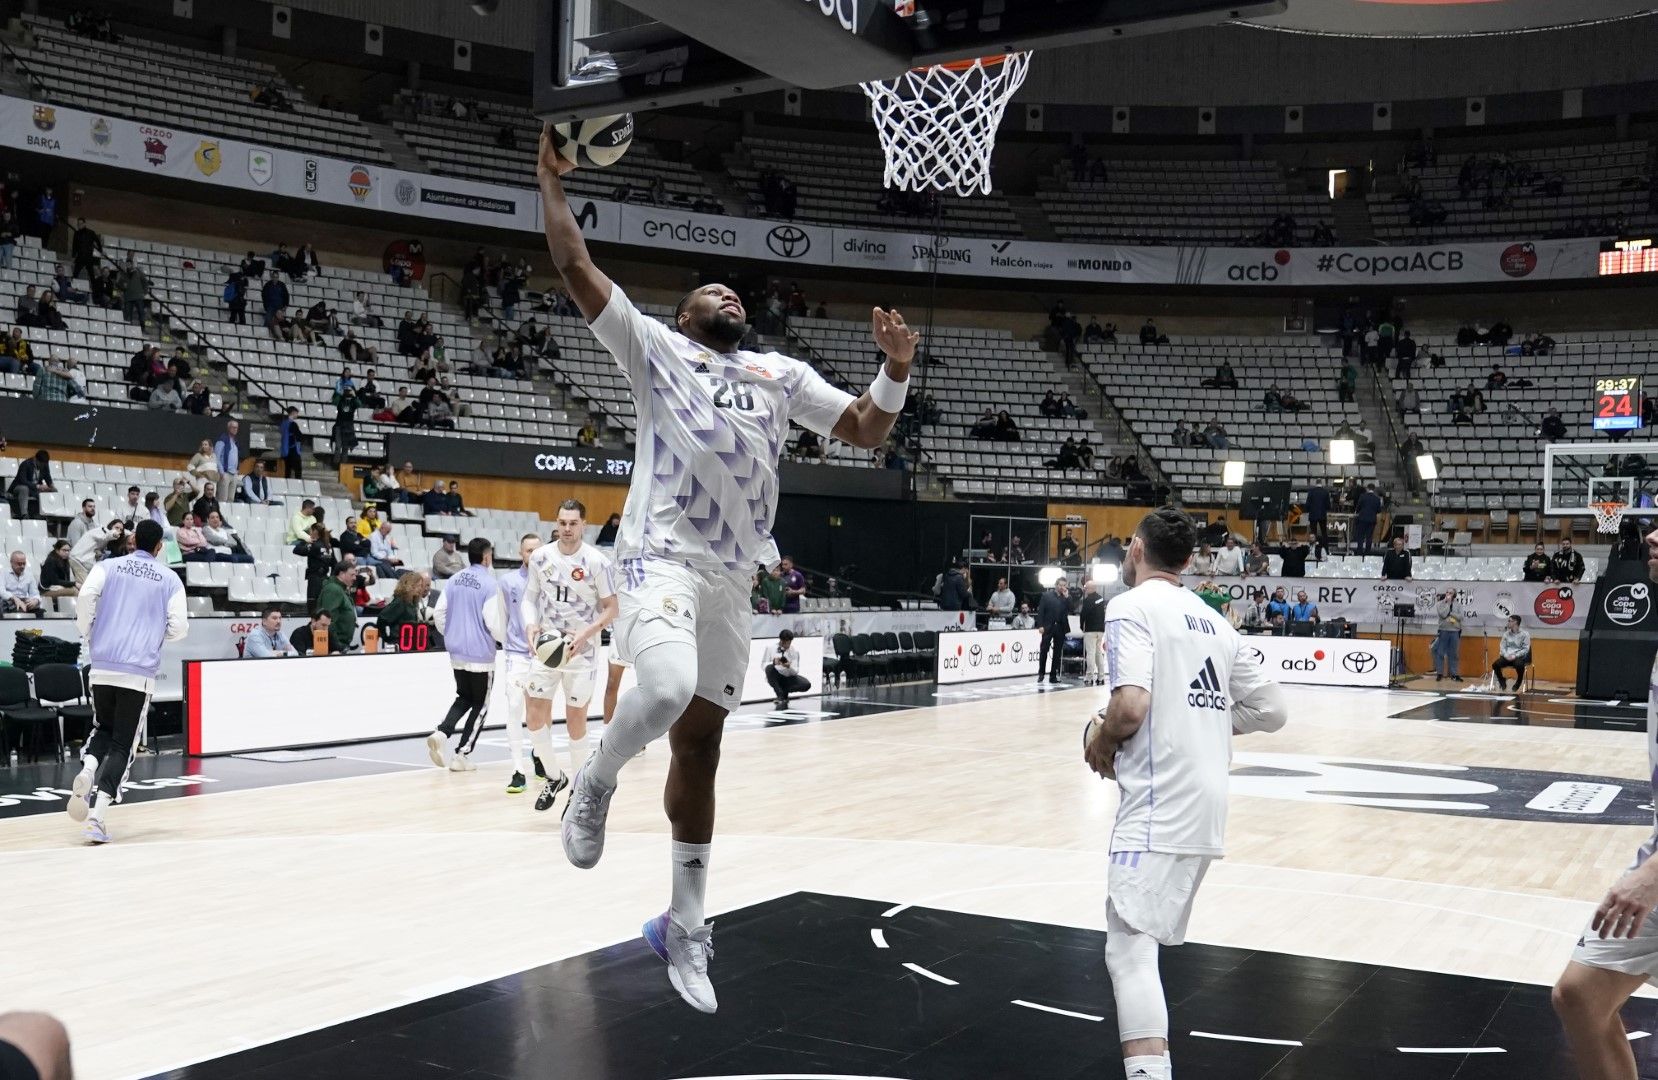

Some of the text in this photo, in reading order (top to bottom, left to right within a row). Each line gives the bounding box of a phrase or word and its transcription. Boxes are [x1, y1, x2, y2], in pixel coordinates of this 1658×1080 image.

[140, 126, 173, 140] CAZOO
[27, 134, 61, 151] BARÇA
[426, 191, 467, 206] Ajuntament
[468, 199, 478, 208] de
[479, 201, 511, 212] Badalona
[643, 220, 736, 247] endesa
[844, 239, 886, 254] divina
[912, 245, 972, 264] SPALDING
[990, 256, 1053, 269] Halcón viajes
[1079, 258, 1132, 271] MONDO
[1317, 251, 1464, 276] #CopaACB
[1227, 262, 1279, 281] acb
[1596, 378, 1637, 391] 29:37
[713, 378, 755, 411] 28
[1599, 395, 1632, 417] 24
[534, 453, 576, 472] COPA
[606, 459, 633, 475] REY
[116, 565, 163, 582] MADRID
[126, 559, 156, 572] REAL
[460, 571, 479, 581] REAL
[556, 585, 568, 603] 11
[1318, 586, 1358, 603] REY
[1612, 600, 1636, 609] Copa
[1622, 607, 1638, 616] Rey
[400, 623, 428, 651] 00
[943, 655, 959, 669] acb
[1281, 658, 1317, 671] acb
